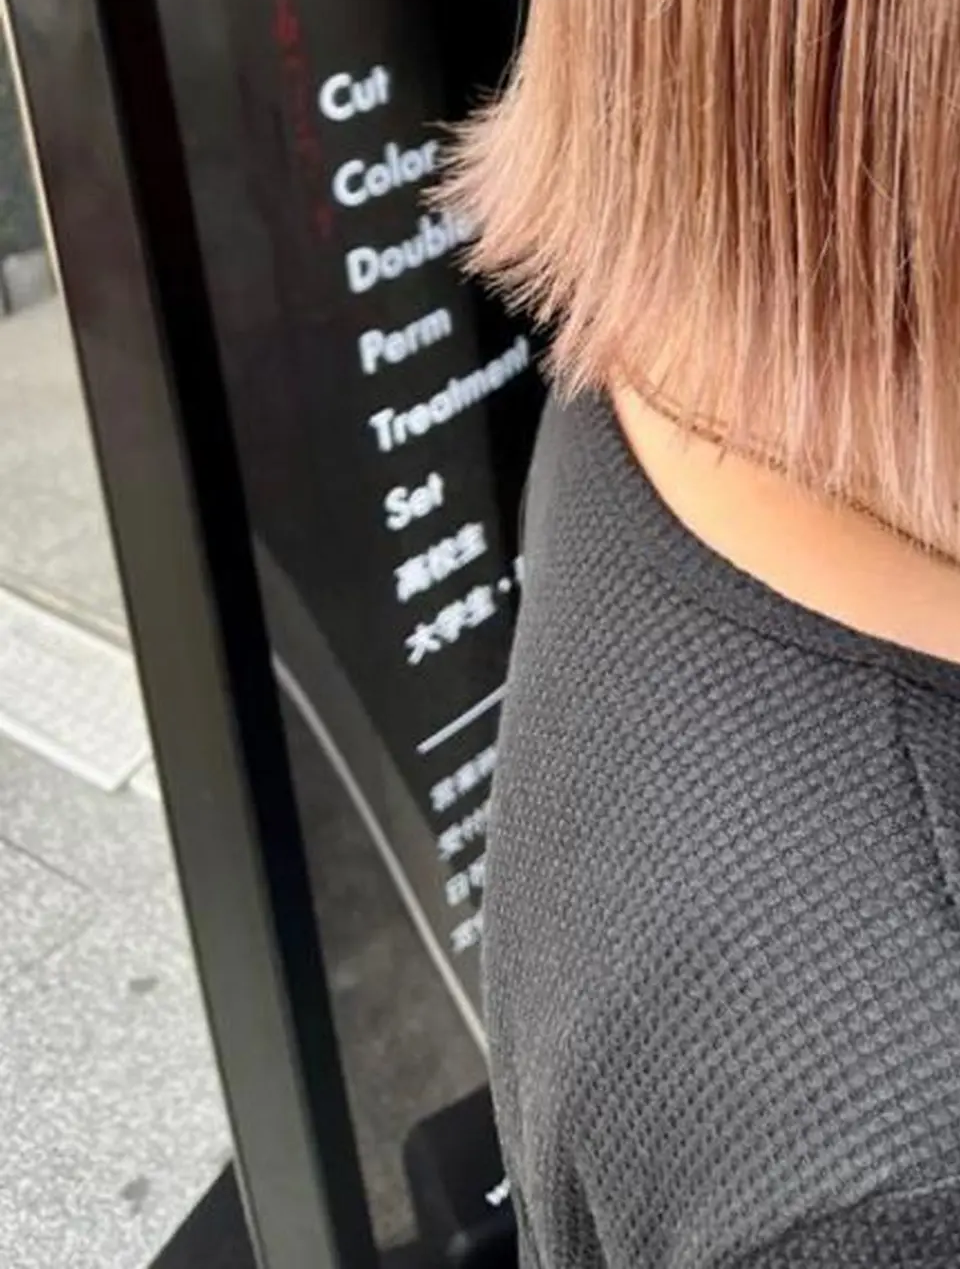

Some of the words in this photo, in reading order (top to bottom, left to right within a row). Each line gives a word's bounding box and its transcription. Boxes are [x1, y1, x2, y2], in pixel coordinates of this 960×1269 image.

[319, 64, 390, 121] Cut
[332, 140, 439, 207] Color
[359, 307, 452, 375] Perm
[368, 335, 531, 452] Treatment
[384, 471, 444, 530] Set
